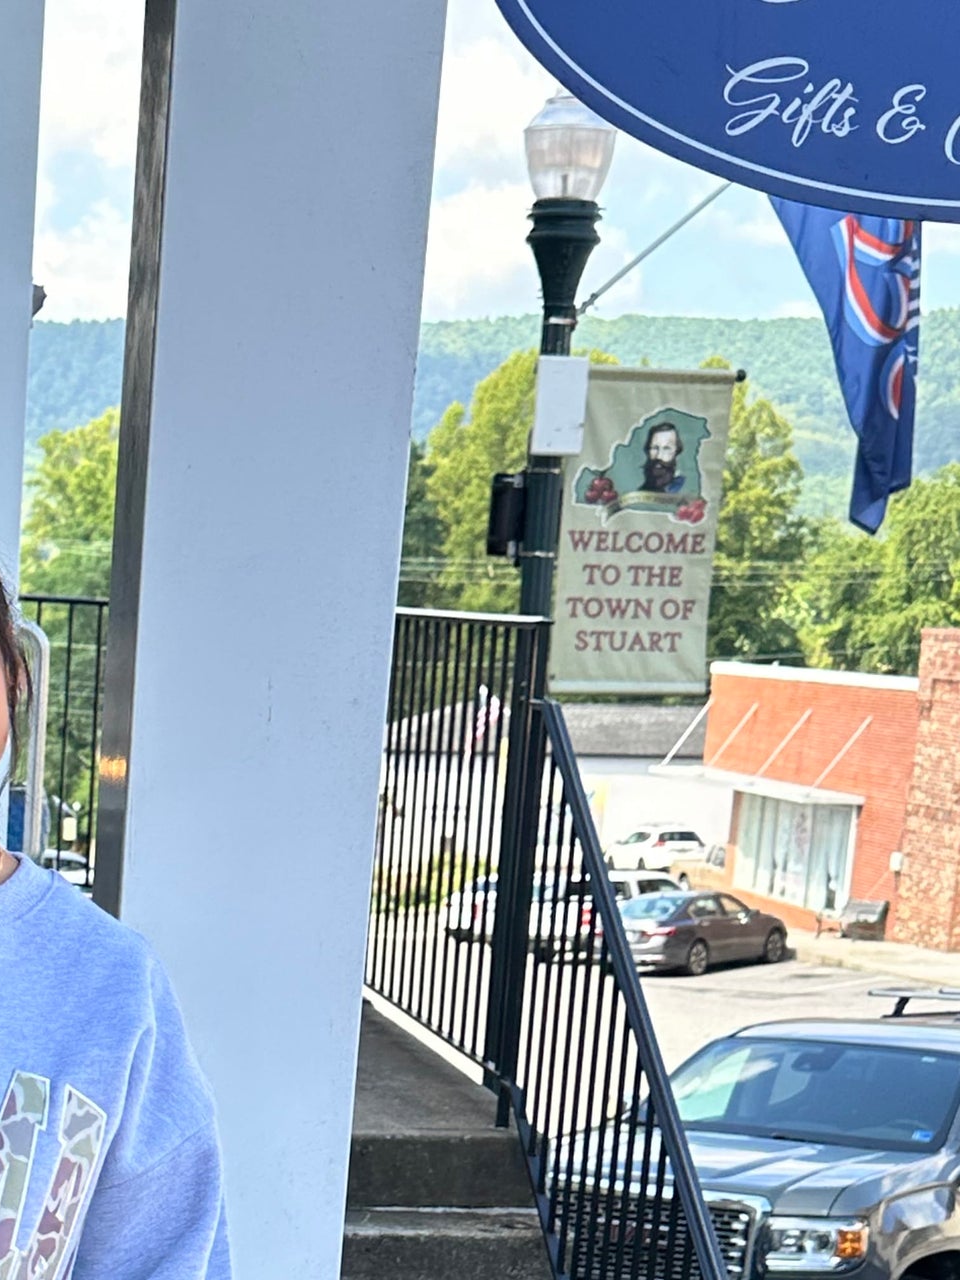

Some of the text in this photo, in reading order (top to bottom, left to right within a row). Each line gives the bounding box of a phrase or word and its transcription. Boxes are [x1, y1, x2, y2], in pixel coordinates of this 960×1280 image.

[723, 56, 859, 147] Gifts
[876, 84, 926, 144] &
[568, 530, 706, 554] WELCOME
[583, 564, 683, 587] TO THE
[566, 597, 696, 620] TOWN OF
[575, 630, 682, 653] STUART
